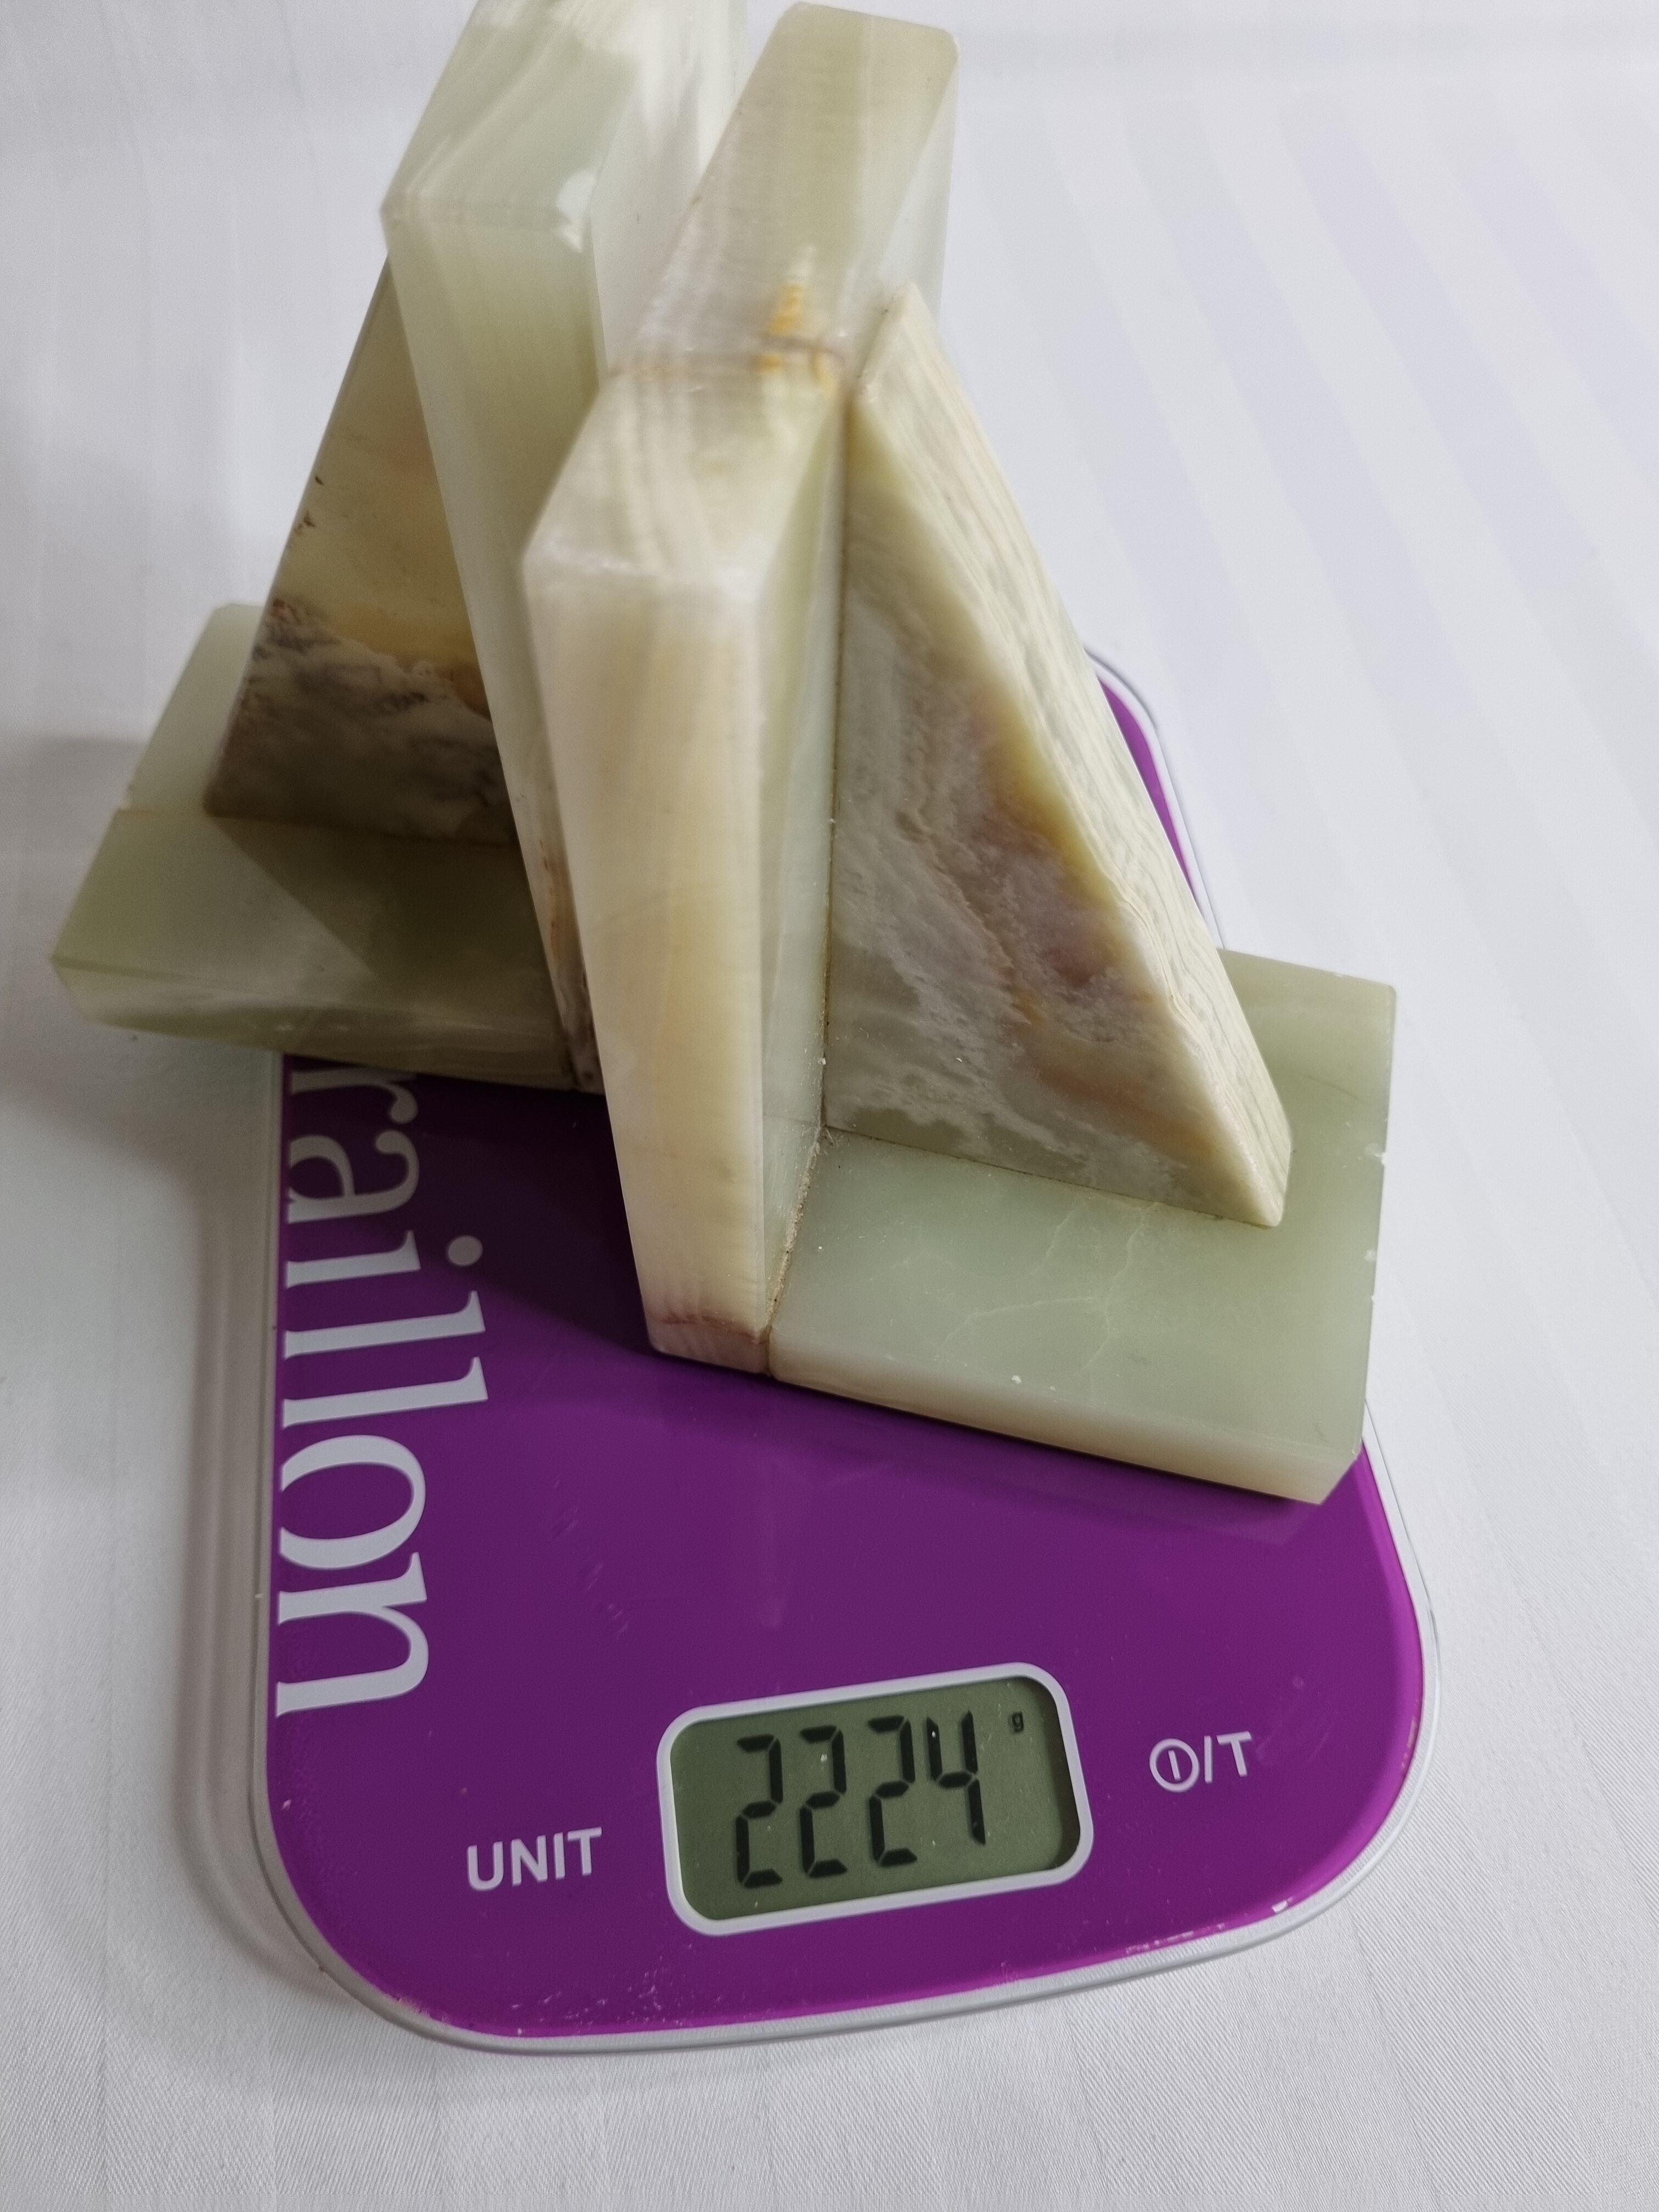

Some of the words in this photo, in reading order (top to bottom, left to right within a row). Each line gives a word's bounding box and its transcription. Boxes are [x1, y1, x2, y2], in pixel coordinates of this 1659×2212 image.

[467, 1826, 602, 1891] UNIT
[735, 1709, 986, 1889] 2224
[1011, 1711, 1024, 1733] g
